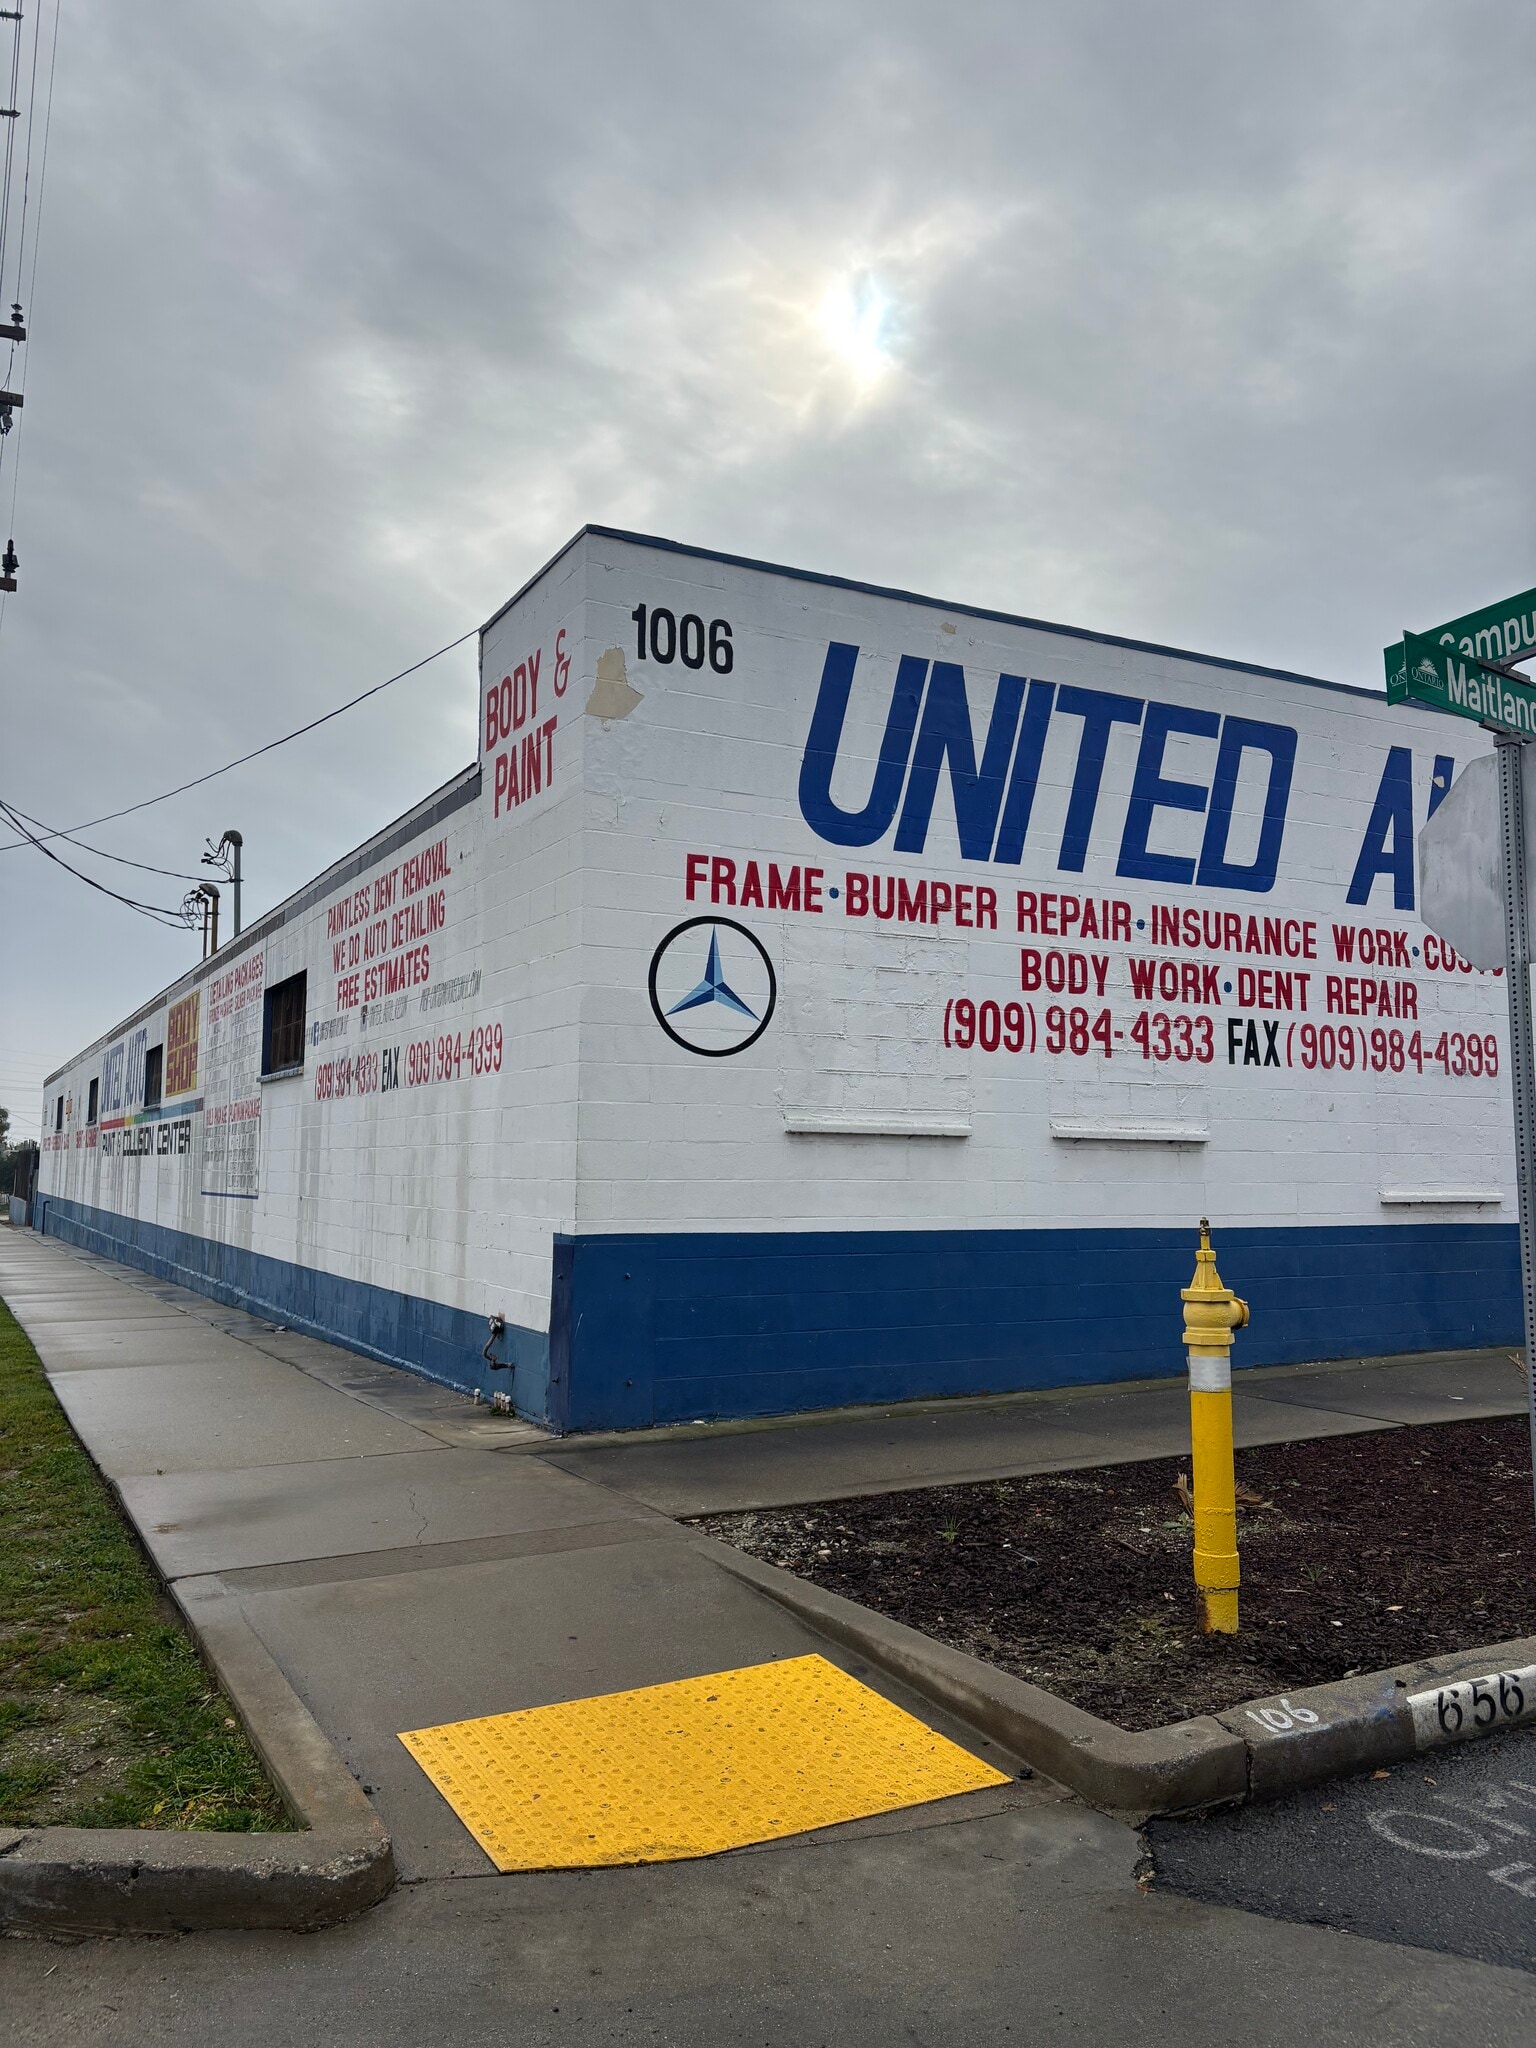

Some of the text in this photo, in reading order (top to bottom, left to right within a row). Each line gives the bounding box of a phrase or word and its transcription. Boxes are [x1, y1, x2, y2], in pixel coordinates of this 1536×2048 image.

[632, 603, 733, 674] 1006
[485, 628, 572, 752] BODY &
[1411, 667, 1444, 689] ONTARIO
[494, 715, 557, 819] PAINT
[798, 641, 1298, 892] UNITED
[327, 837, 452, 940] PAINTLESS DENT REMOVAL
[686, 853, 824, 913] FRAME
[845, 872, 998, 930] BUMPER
[1017, 890, 1132, 942] REPAIR
[1151, 904, 1317, 959] INSURANCE
[1332, 924, 1411, 968] WORK
[333, 889, 445, 974] WE DO AUTO DETAILING
[337, 973, 360, 1012] FREE
[364, 944, 430, 1002] ESTIMATES
[1021, 949, 1418, 1020] BODY WORK DENT REPAIR
[167, 993, 199, 1051] BODY
[1227, 1017, 1281, 1067] FAX
[166, 1042, 198, 1094] SHOP
[382, 1046, 400, 1093] FAX
[156, 1119, 191, 1156] CENTER
[1245, 1699, 1319, 1734] 106
[1438, 1672, 1524, 1734] 656
